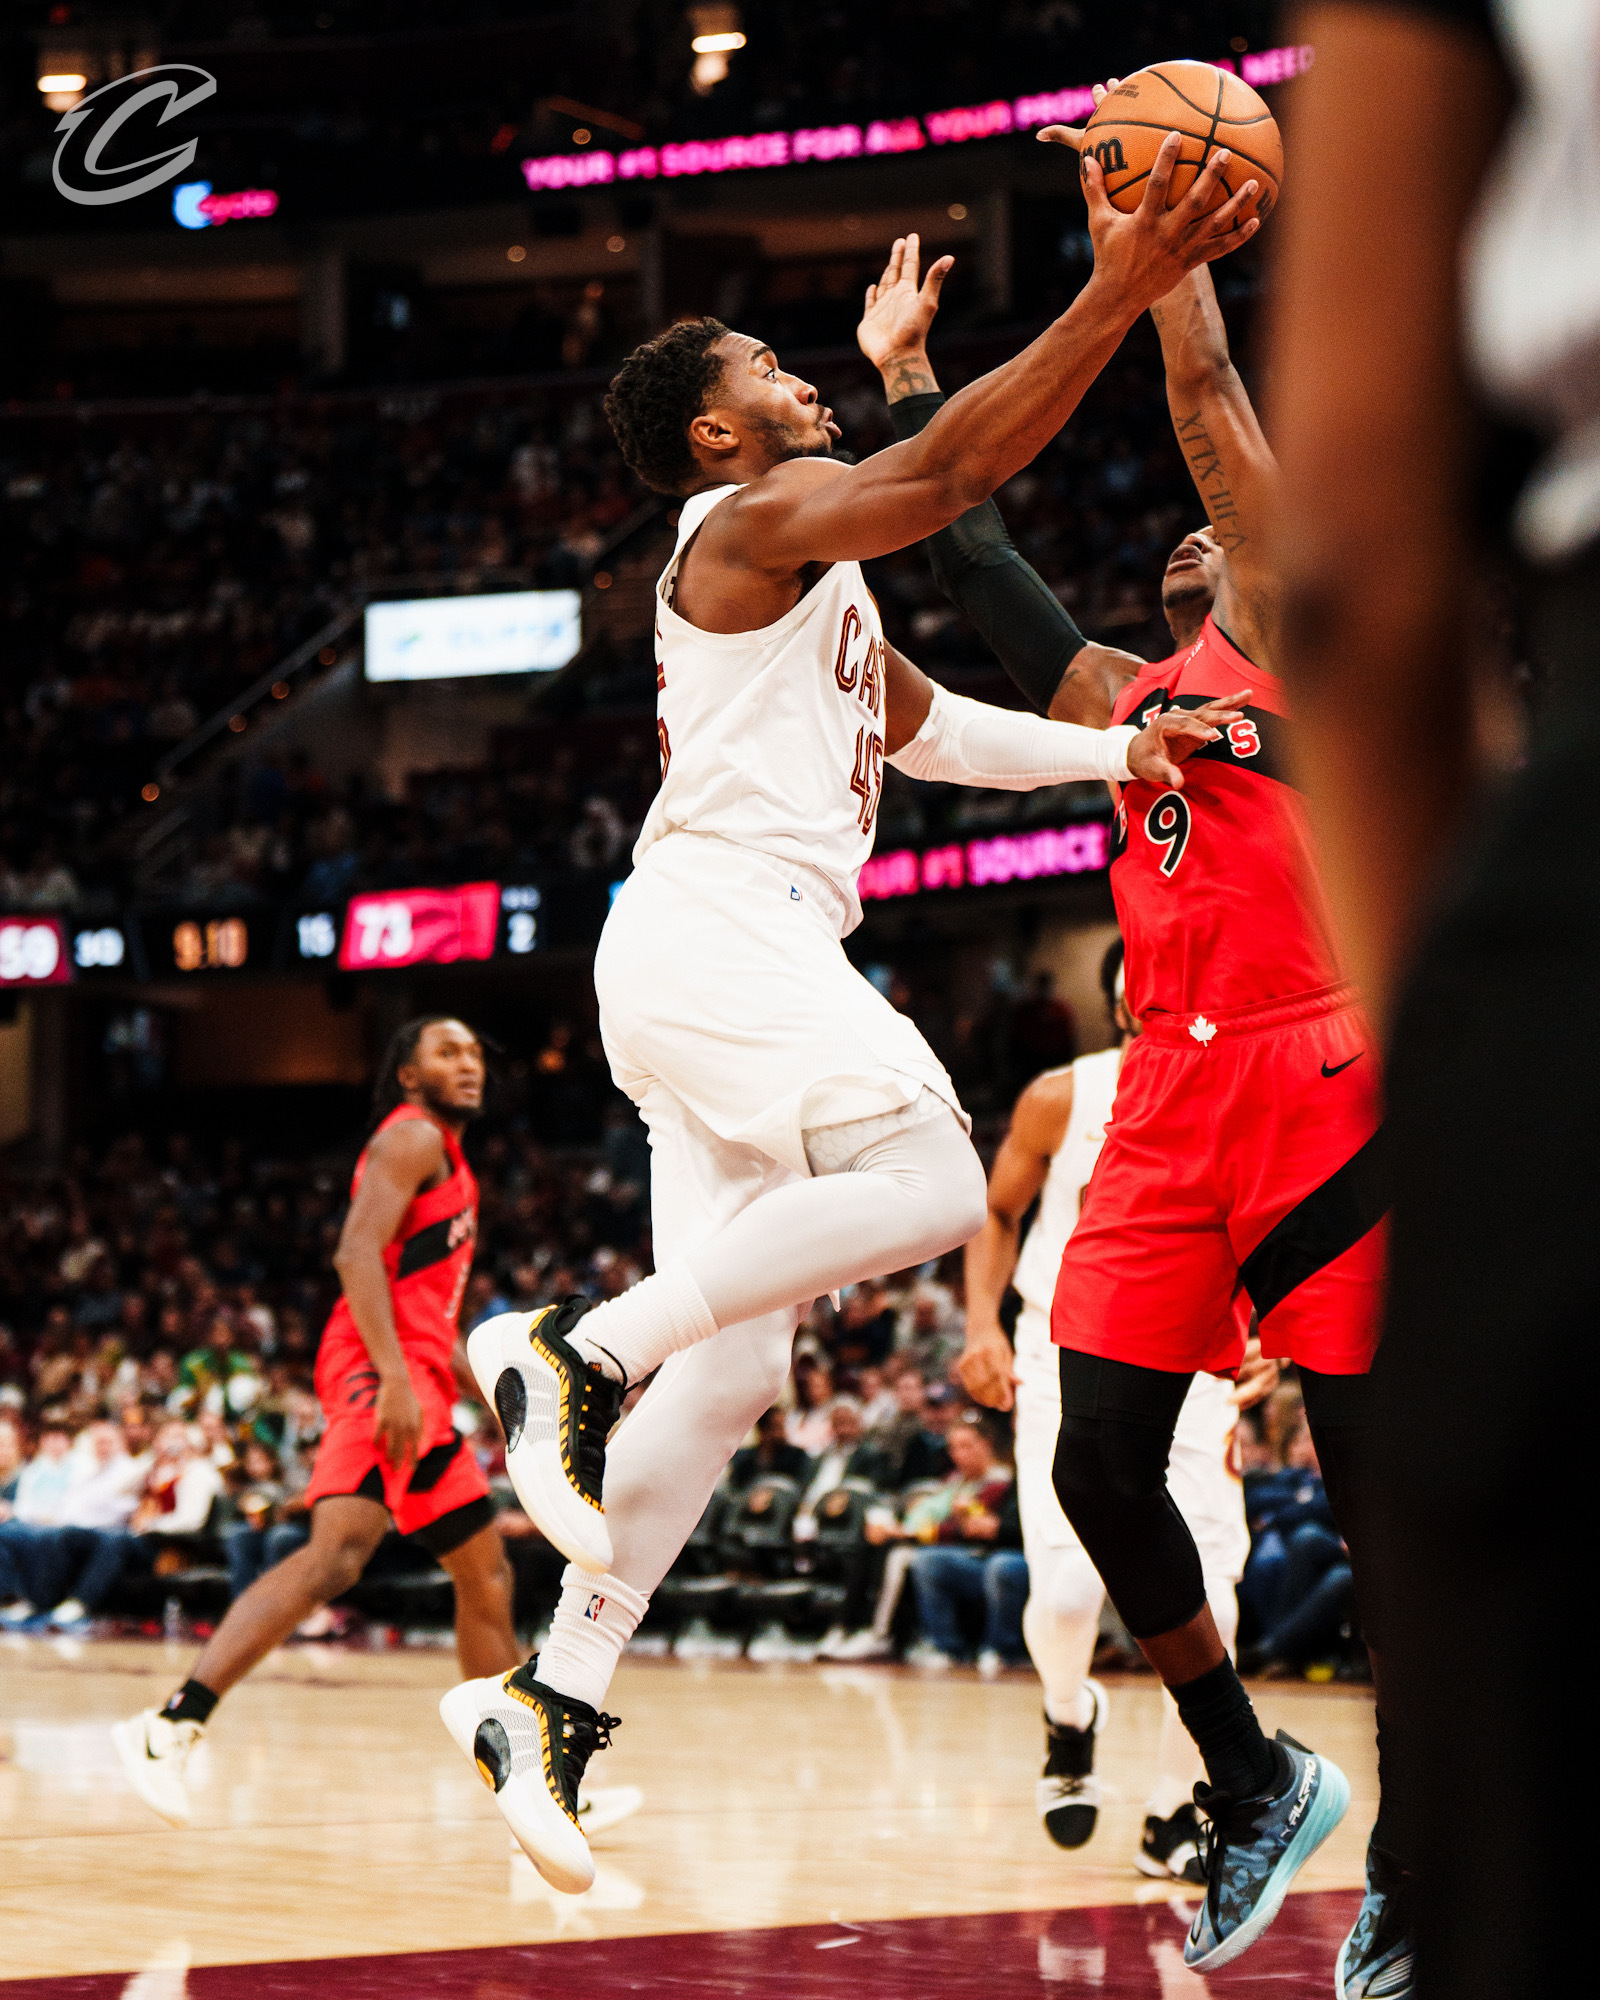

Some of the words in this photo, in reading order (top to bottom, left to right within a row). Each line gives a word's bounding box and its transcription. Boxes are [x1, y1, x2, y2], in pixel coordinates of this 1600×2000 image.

[522, 150, 614, 191] YOUR
[660, 131, 790, 178] SOURCE
[792, 123, 862, 163] FOR
[865, 117, 926, 155] ALL
[924, 100, 1012, 146] YOUR
[850, 724, 884, 837] 45
[966, 822, 1108, 886] SOURCE
[1144, 790, 1191, 878] 9
[355, 902, 413, 961] 73
